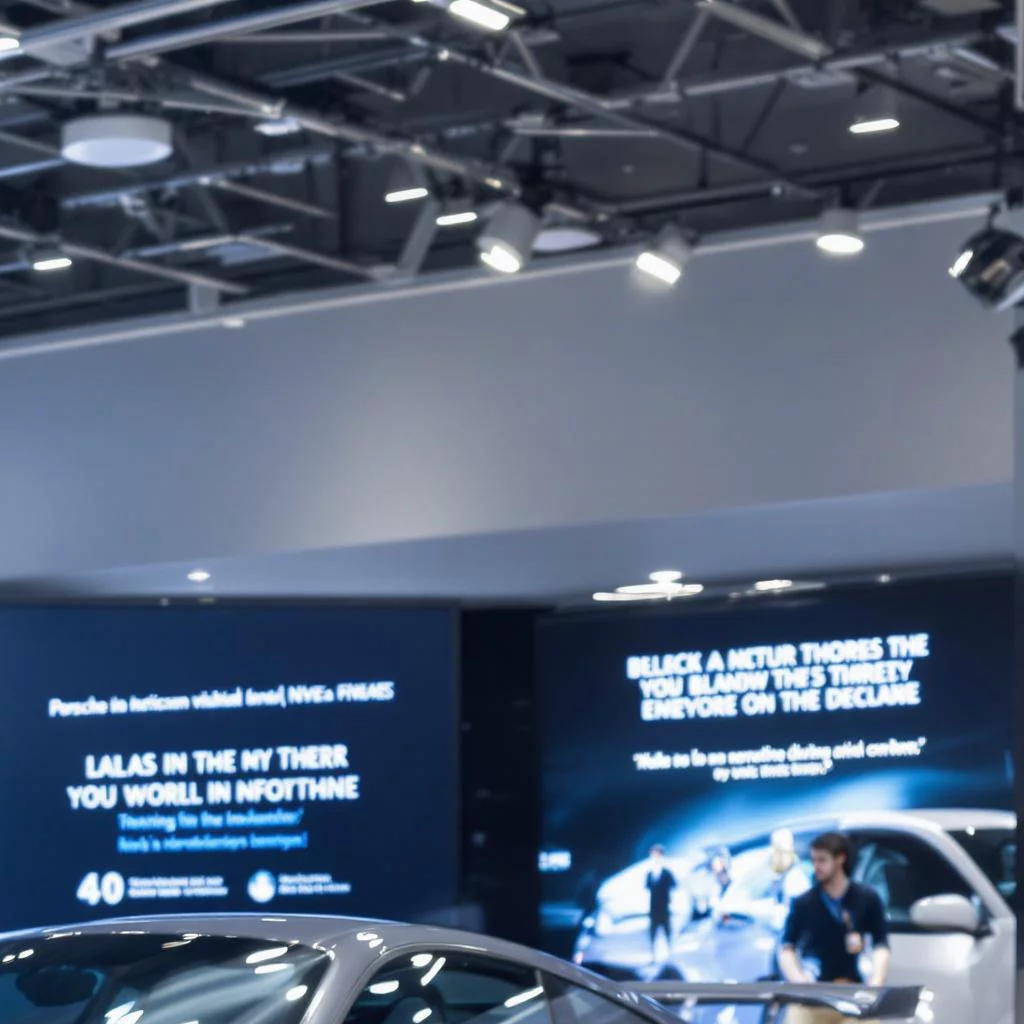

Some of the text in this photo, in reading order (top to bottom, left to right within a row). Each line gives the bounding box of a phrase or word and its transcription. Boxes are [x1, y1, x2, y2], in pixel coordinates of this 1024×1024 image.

[706, 651, 724, 672] A
[887, 634, 929, 657] THE
[741, 692, 776, 715] ON
[778, 687, 820, 711] THE
[86, 753, 157, 779] LALAS
[163, 753, 187, 774] IN
[193, 750, 236, 773] THE
[67, 785, 117, 808] YOU
[207, 782, 231, 803] IN
[77, 872, 124, 905] 40
